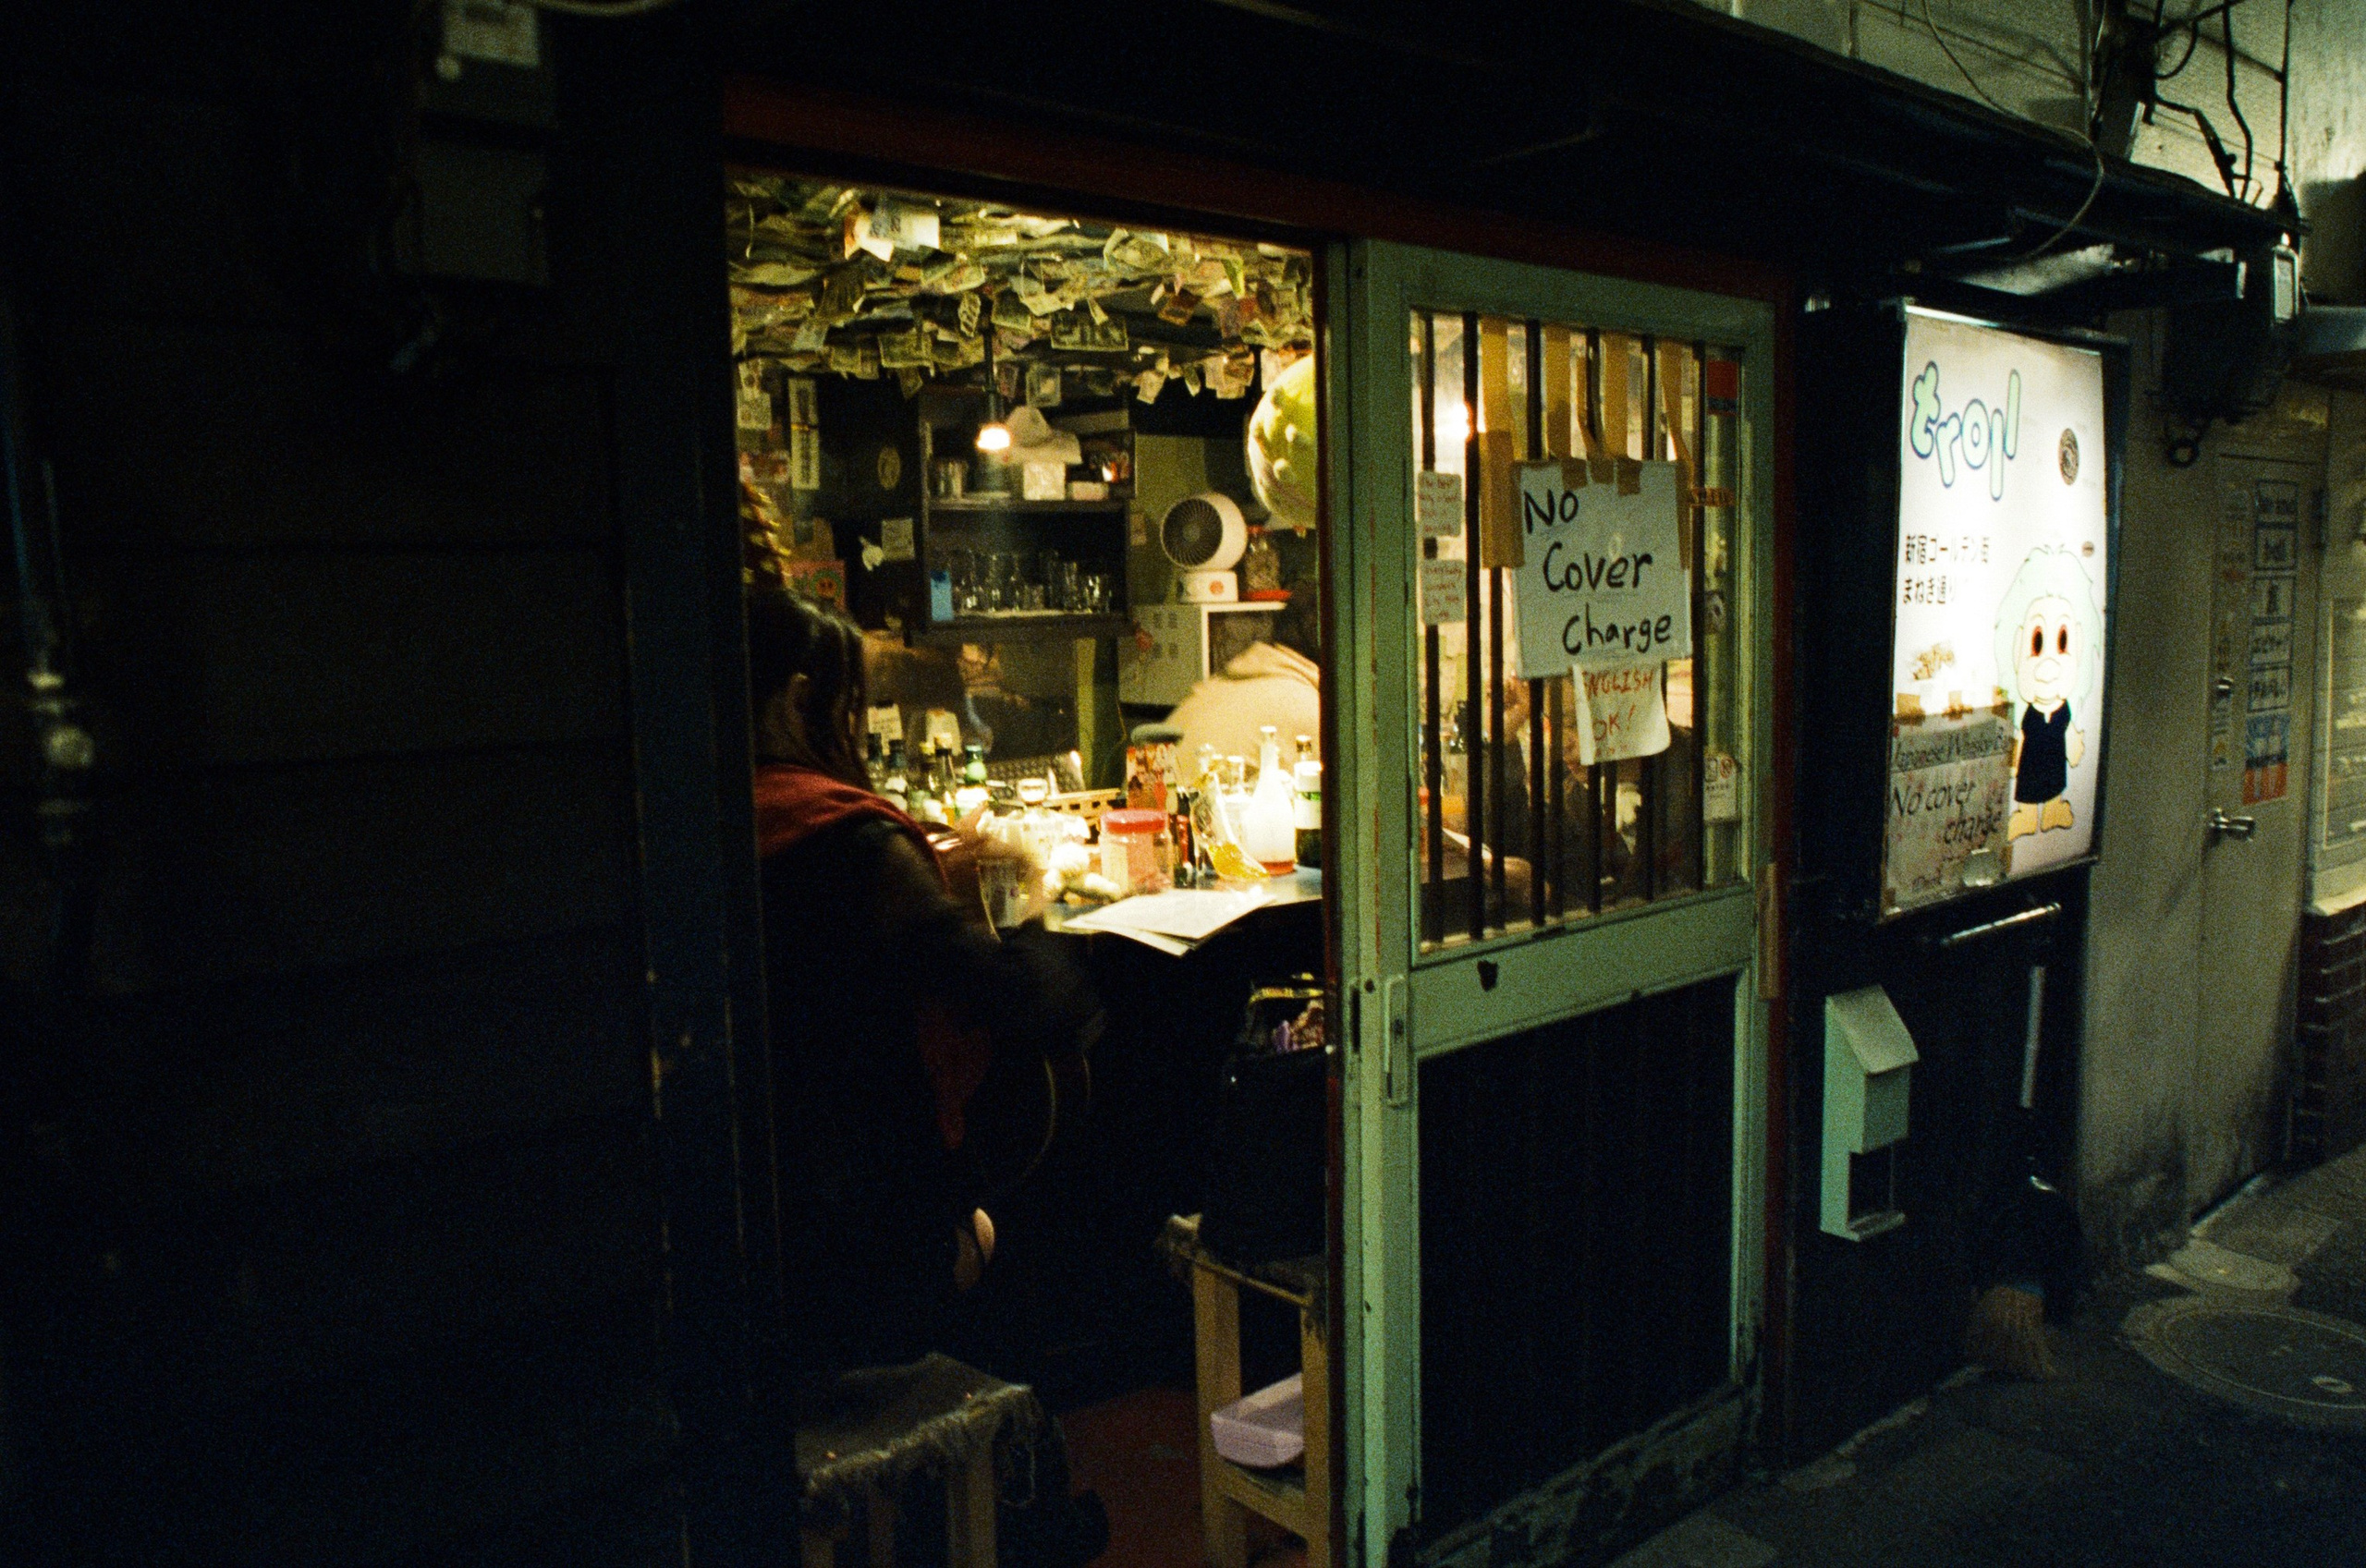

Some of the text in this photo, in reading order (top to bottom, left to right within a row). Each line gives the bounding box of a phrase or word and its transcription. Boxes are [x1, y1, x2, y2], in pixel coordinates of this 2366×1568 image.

[1910, 360, 2021, 502] troll
[1543, 541, 1654, 592] Cover
[1563, 602, 1672, 656] Charge
